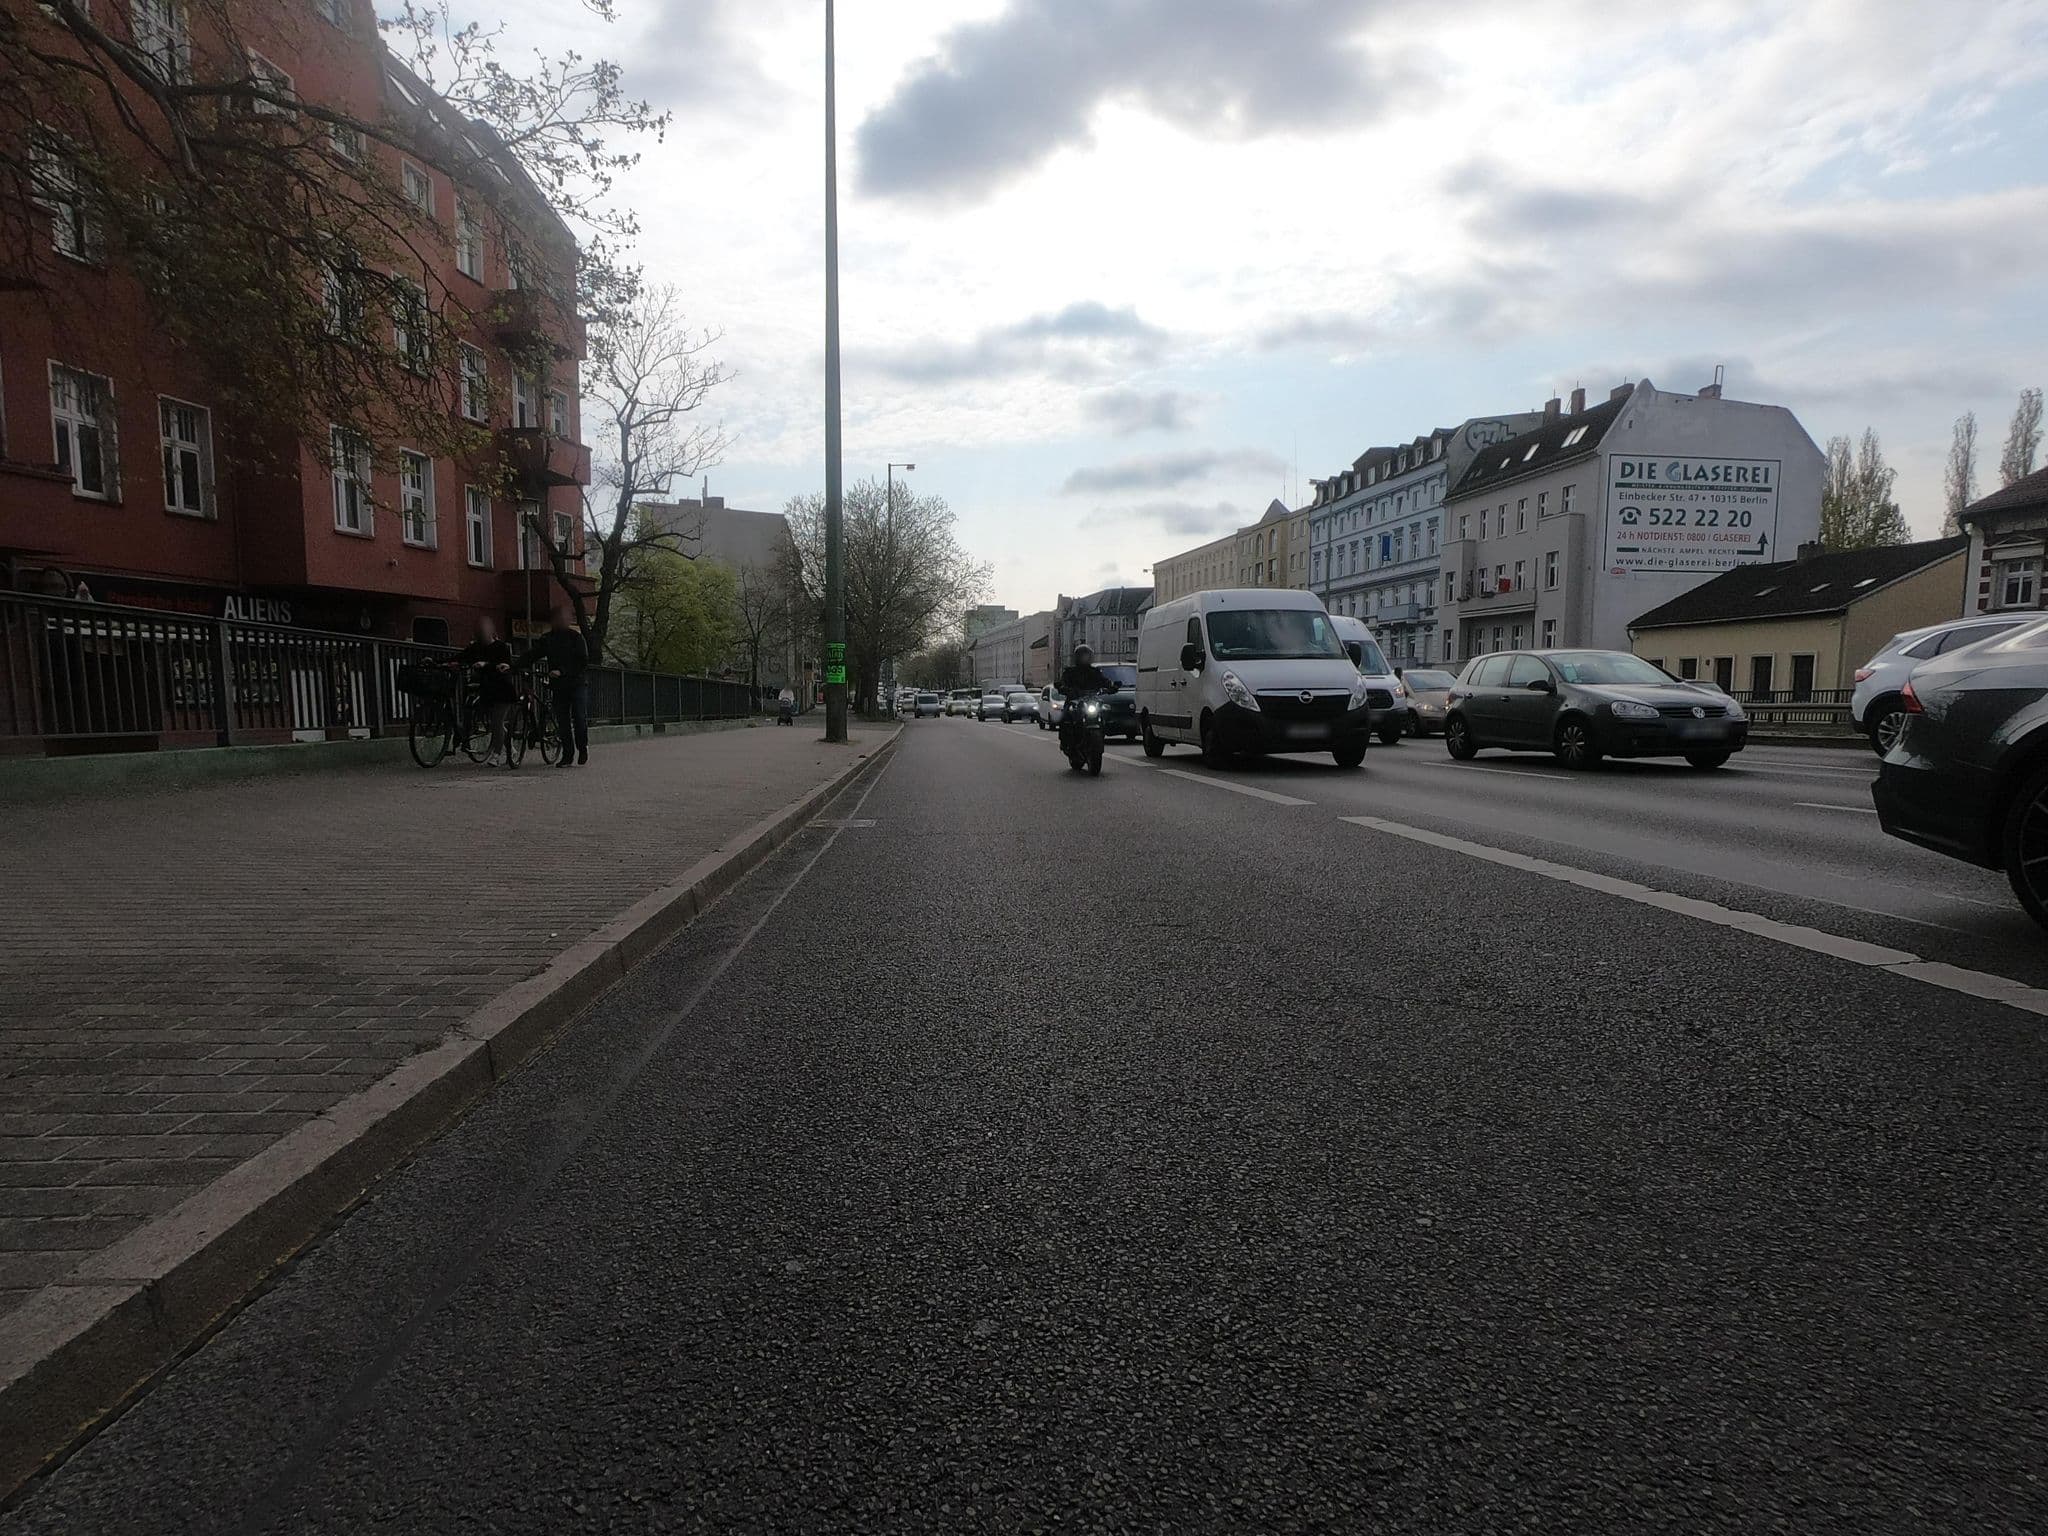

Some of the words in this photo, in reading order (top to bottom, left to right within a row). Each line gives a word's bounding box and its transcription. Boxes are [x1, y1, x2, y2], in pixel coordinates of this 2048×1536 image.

[1620, 461, 1657, 480] DIE
[1665, 461, 1770, 484] GLASEREI
[1619, 491, 1666, 502] Einbecker
[1669, 493, 1686, 502] Str.
[1687, 494, 1700, 502] 47
[1710, 494, 1738, 503] 10315
[1739, 495, 1769, 505] Berlin
[1648, 507, 1687, 526] 522
[1694, 509, 1720, 527] 22
[1727, 509, 1752, 528] 20
[1616, 530, 1627, 540] 24
[1636, 531, 1685, 542] NOTDIENST:
[1712, 533, 1752, 544] GLASEREI
[1679, 547, 1705, 555] AMPEL
[1707, 548, 1736, 556] RECHTS
[224, 595, 292, 624] ALIENS
